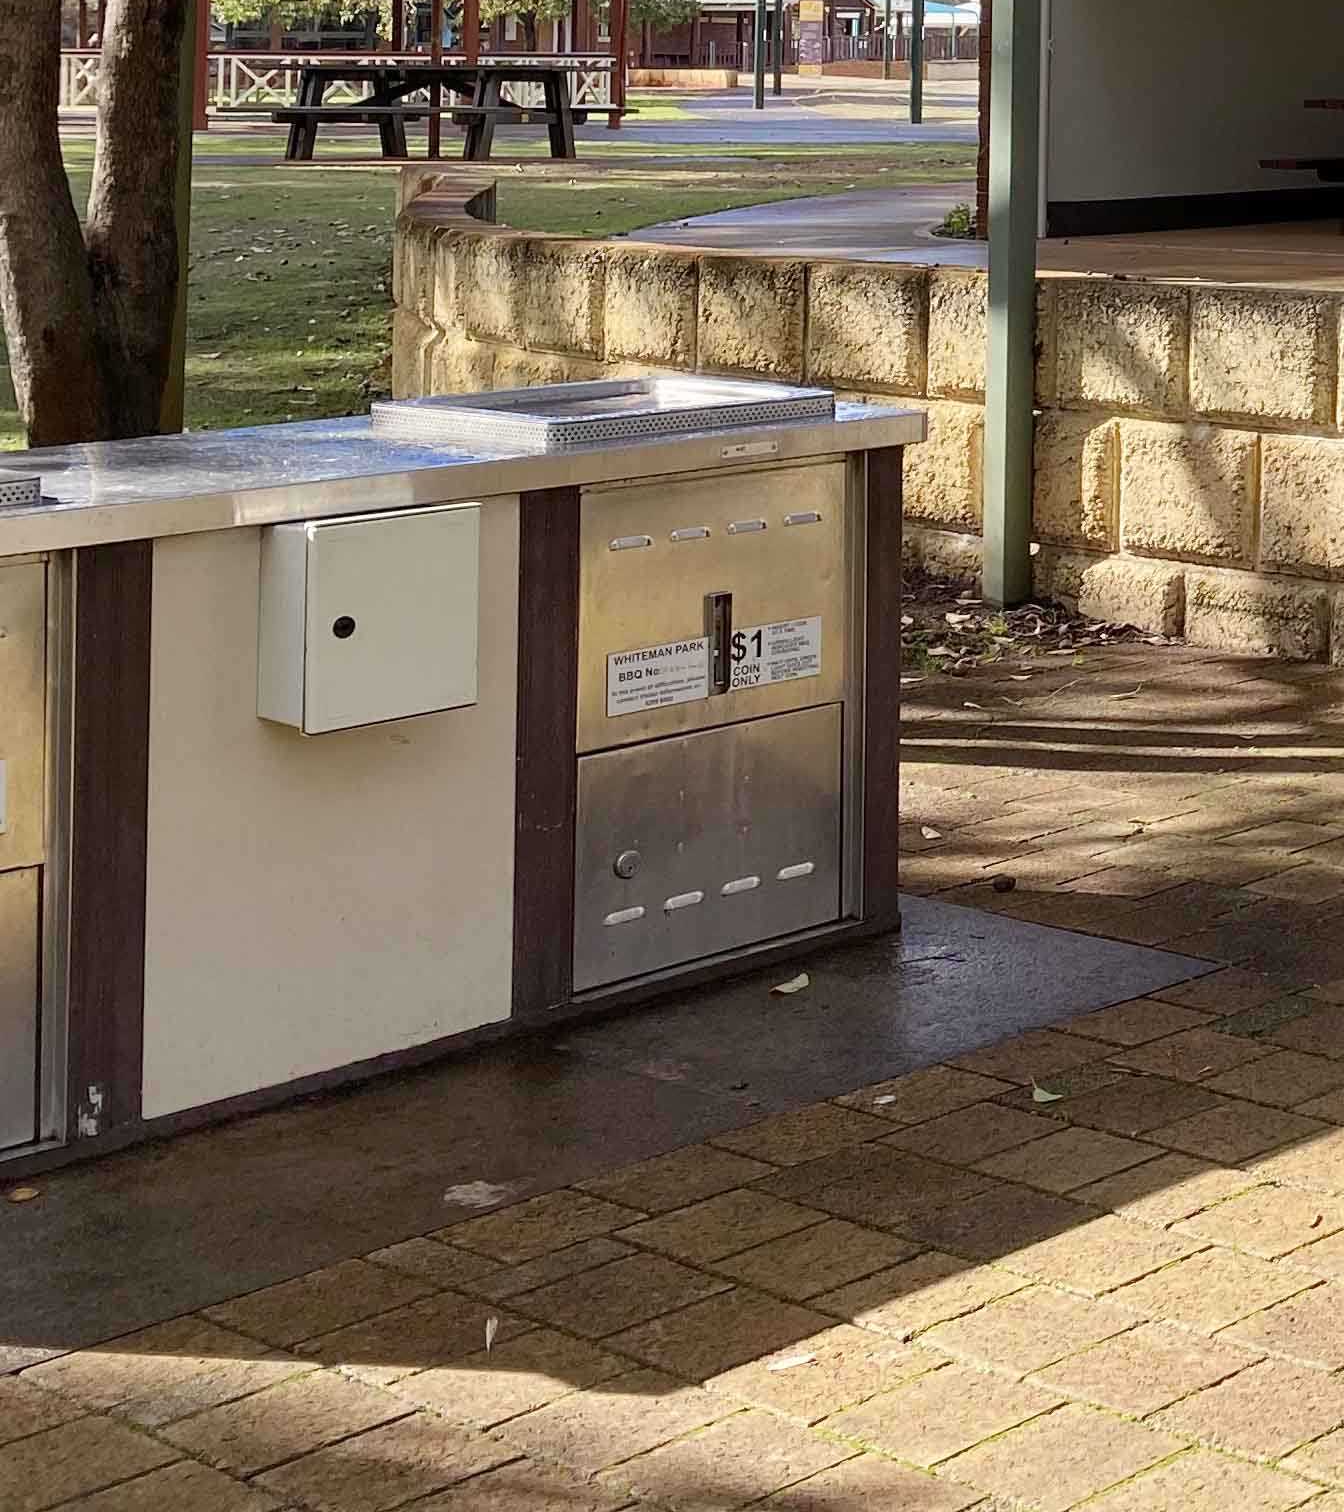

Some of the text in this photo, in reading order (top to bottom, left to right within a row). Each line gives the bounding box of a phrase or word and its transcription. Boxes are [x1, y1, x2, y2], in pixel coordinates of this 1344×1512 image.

[614, 641, 705, 666] WHITEMAN PARK
[731, 629, 762, 665] $1
[618, 669, 642, 682] BBQ
[733, 663, 760, 676] COIN
[732, 674, 760, 687] ONLY
